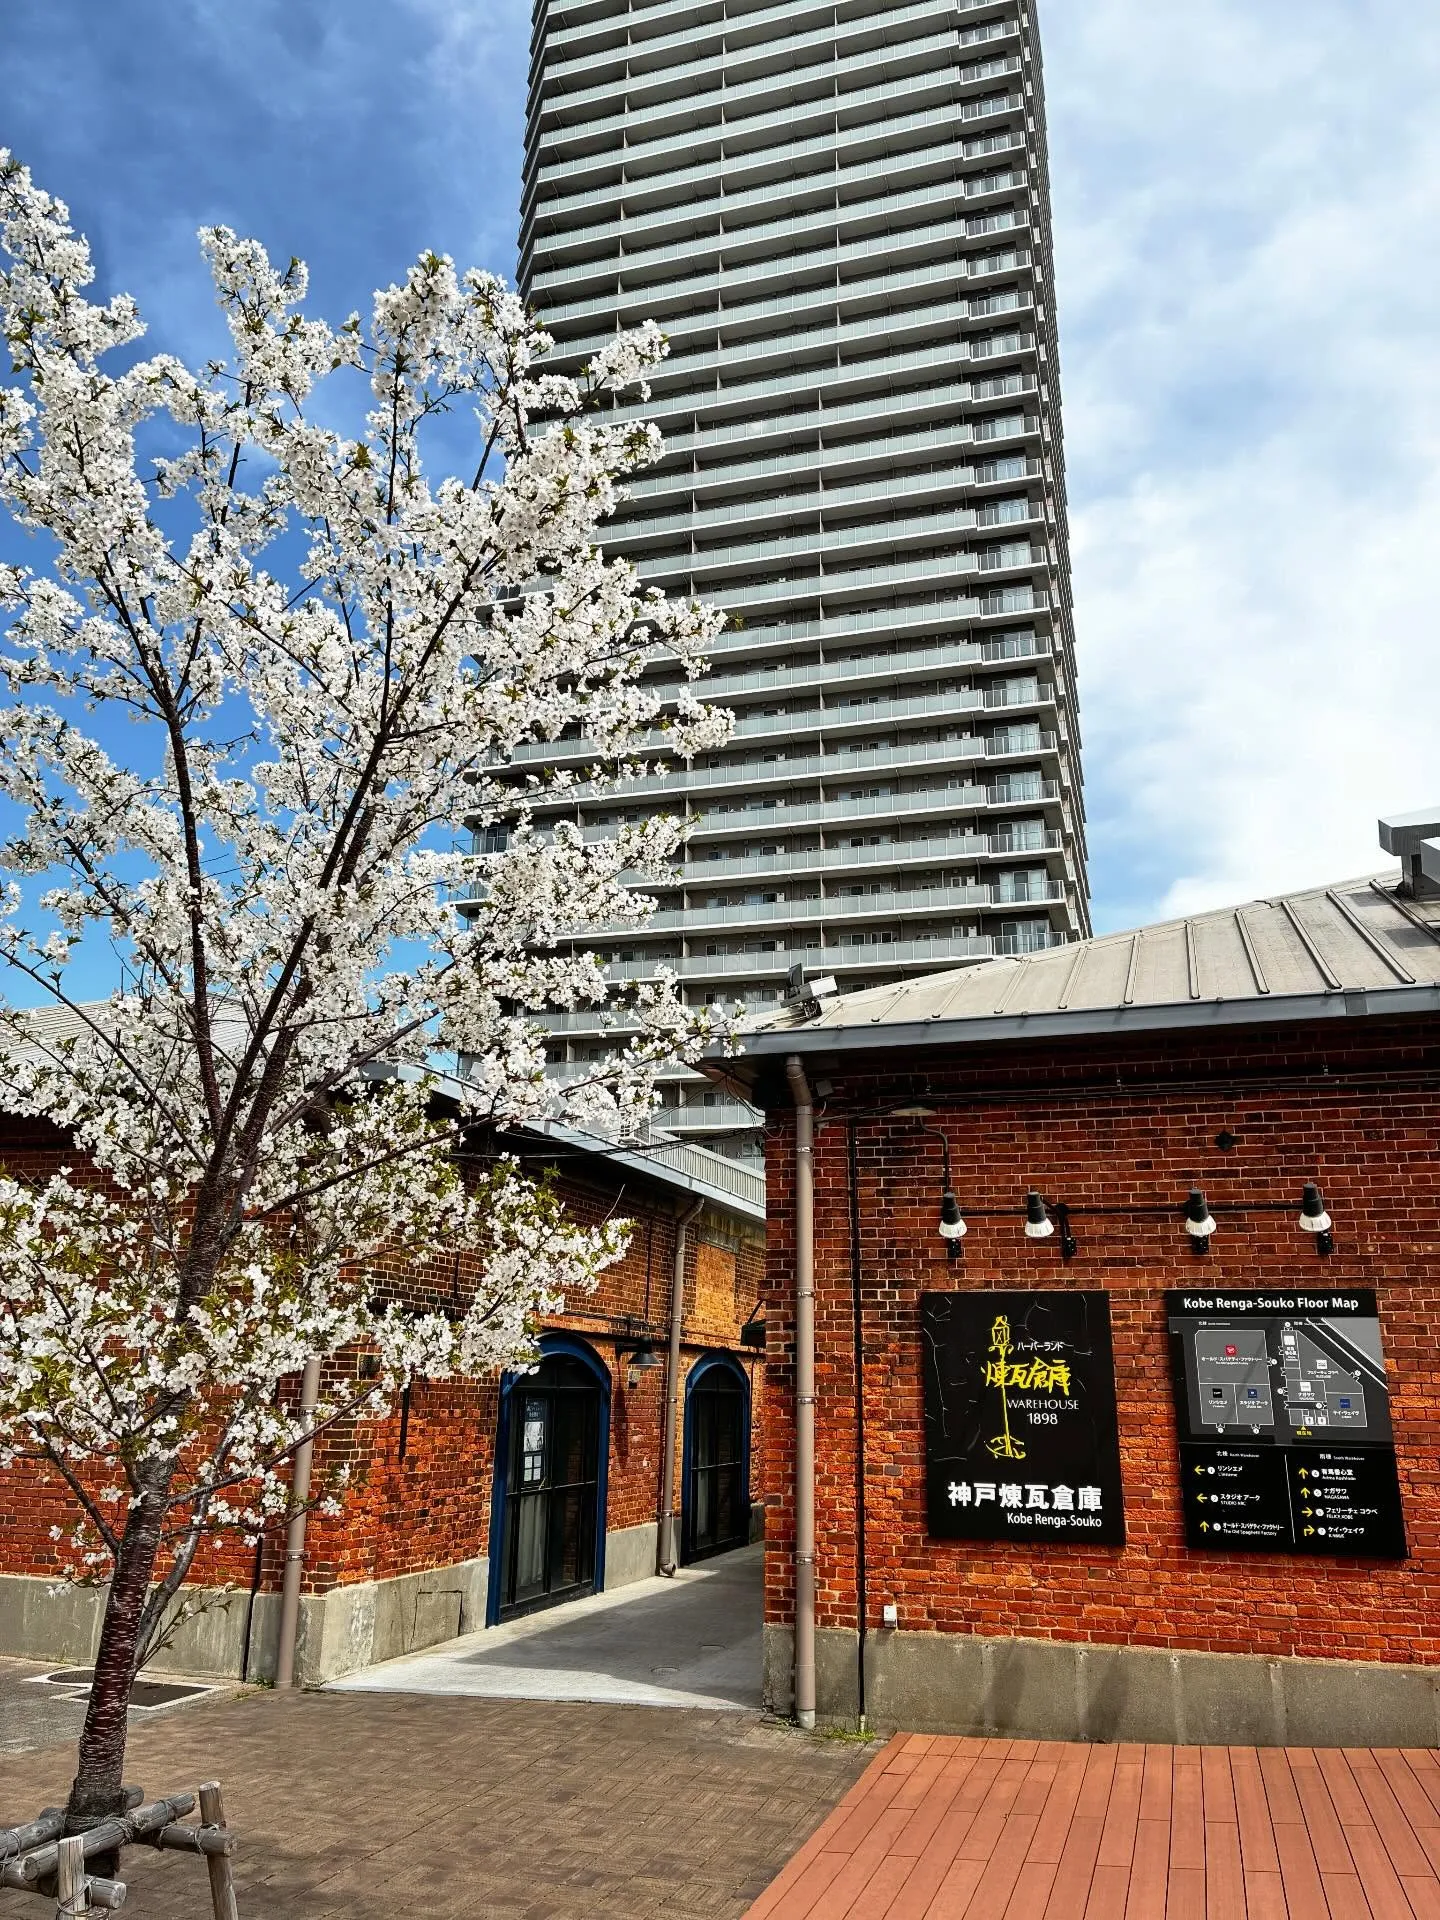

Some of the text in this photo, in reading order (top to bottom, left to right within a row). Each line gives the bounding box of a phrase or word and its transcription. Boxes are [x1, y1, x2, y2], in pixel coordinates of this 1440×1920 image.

[1184, 1298, 1358, 1313] Kobe Renga-Souko Floor Map
[1017, 1342, 1063, 1351] ハーバーランド
[1007, 1399, 1079, 1410] WAREHOUSE
[1026, 1413, 1058, 1425] 1898
[948, 1482, 1102, 1511] 神戸煉瓦倉庫
[1007, 1513, 1102, 1528] Kobe Renga-Souko
